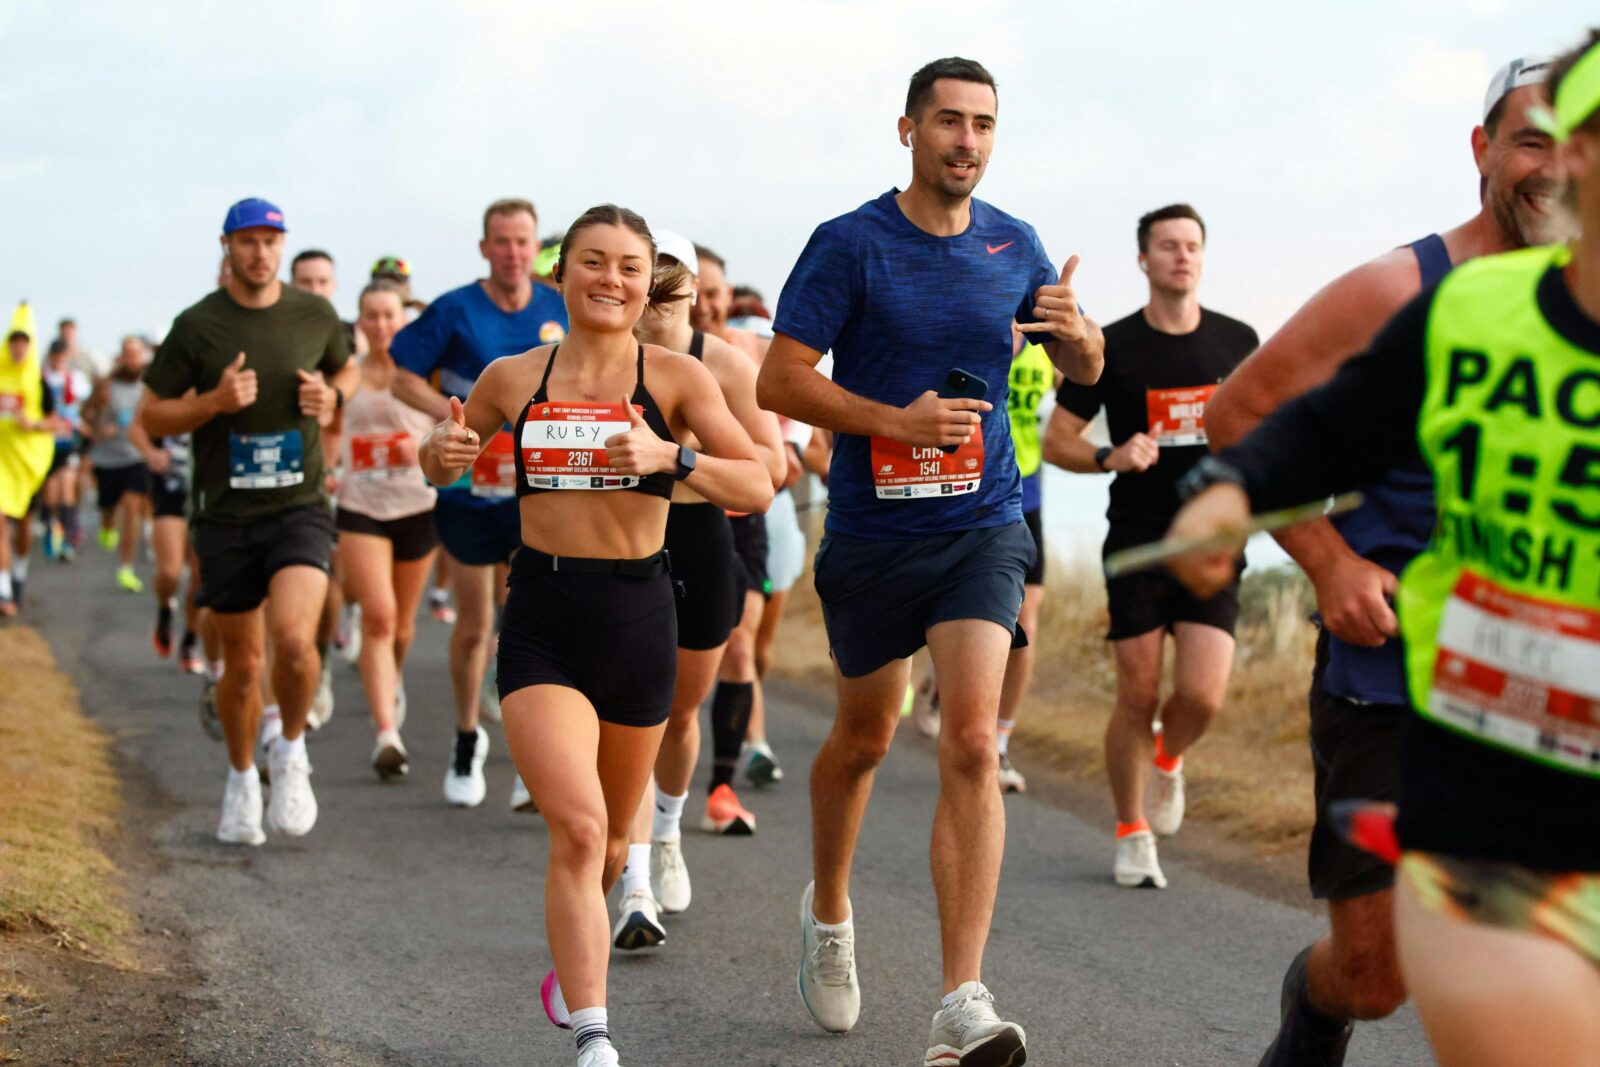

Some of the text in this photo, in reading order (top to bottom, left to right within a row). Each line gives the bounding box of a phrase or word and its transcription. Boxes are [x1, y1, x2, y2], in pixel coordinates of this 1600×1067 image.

[546, 424, 601, 442] RUBY
[567, 451, 594, 466] 2361
[920, 461, 940, 476] 1541
